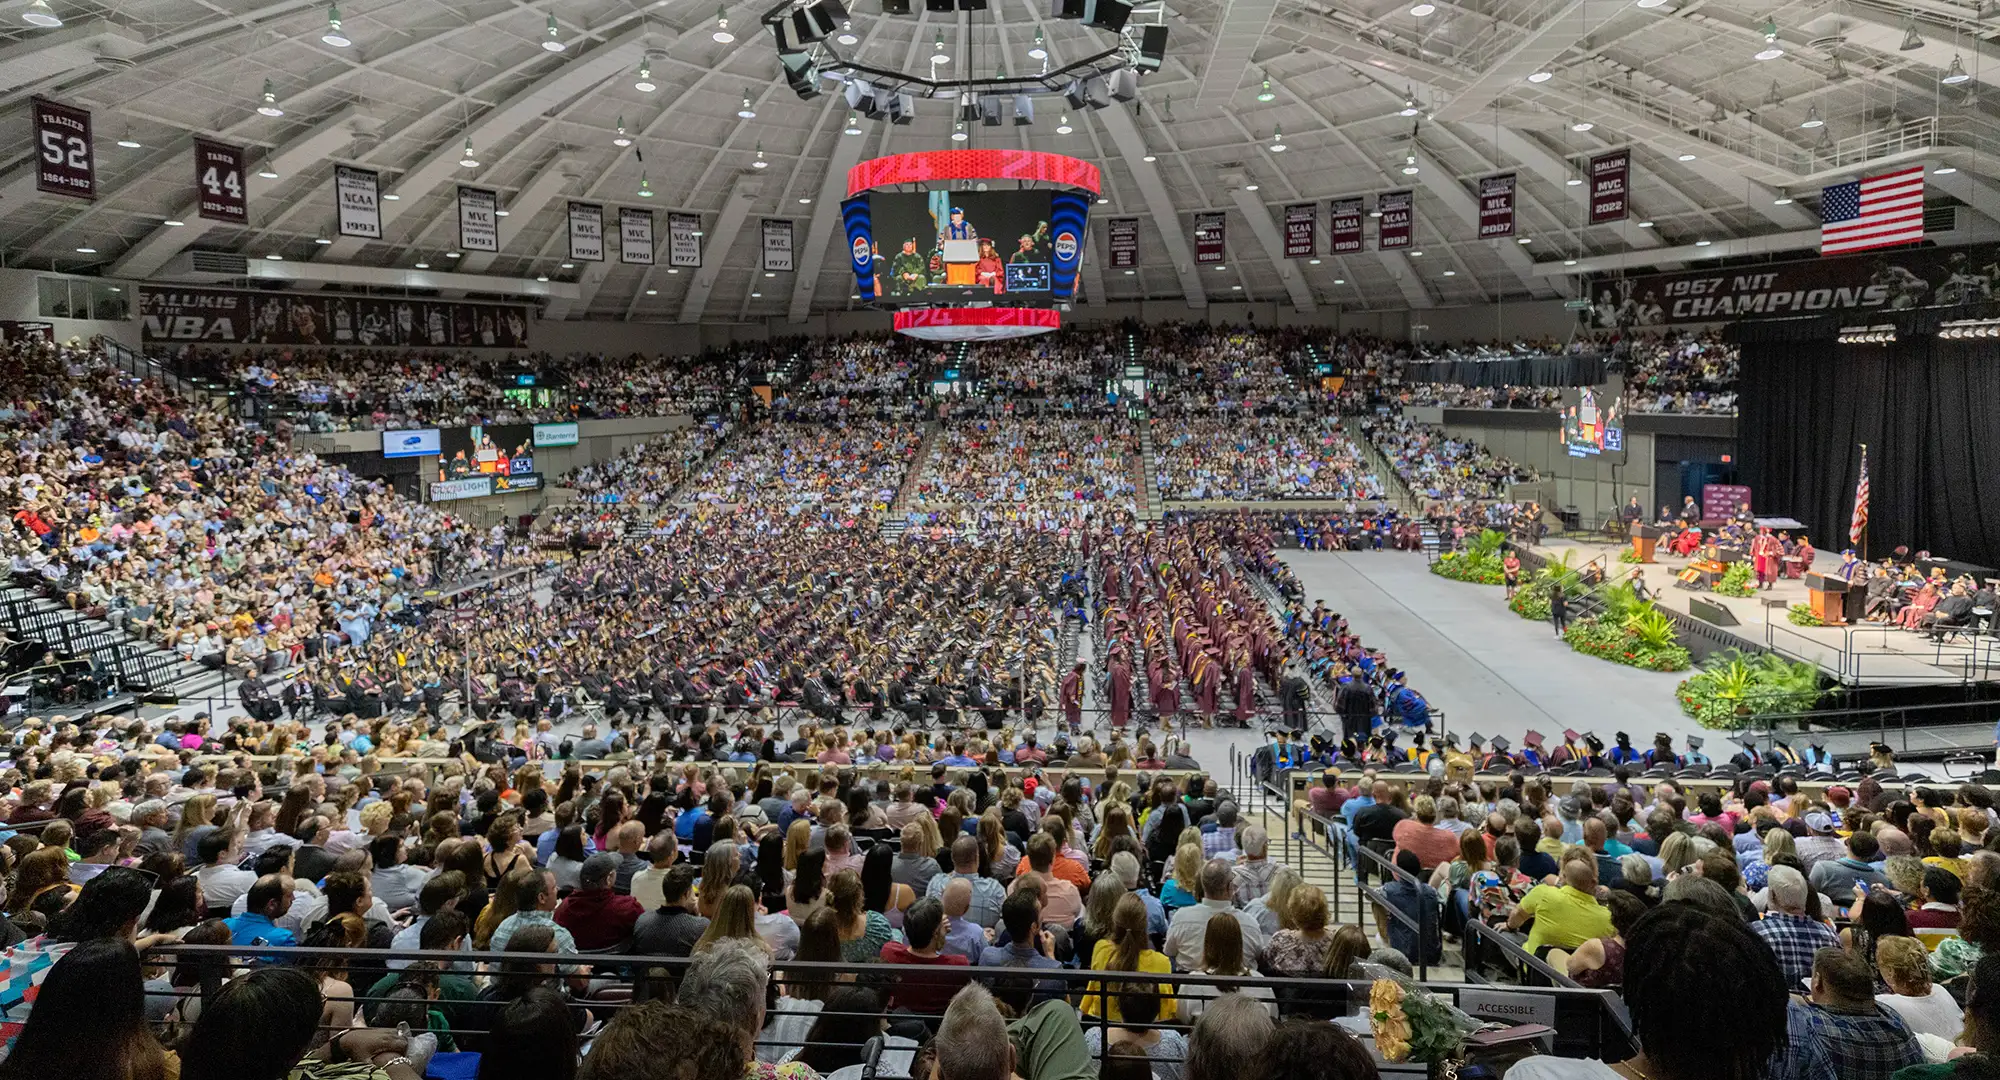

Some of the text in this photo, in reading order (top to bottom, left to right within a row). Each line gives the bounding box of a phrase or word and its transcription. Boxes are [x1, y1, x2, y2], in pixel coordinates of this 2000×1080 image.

[42, 114, 85, 132] FRAZIER
[41, 130, 88, 170] 52
[1595, 158, 1626, 172] SALUKI
[43, 172, 90, 188] 1964-1967
[202, 166, 242, 198] 44
[1598, 179, 1621, 191] MVC
[344, 192, 373, 206] NCAA
[1487, 198, 1507, 209] MVC
[1596, 201, 1622, 214] 2022
[468, 211, 488, 221] MVC
[1384, 212, 1408, 223] NCAA
[346, 222, 375, 232] 1993
[1289, 223, 1311, 233] NCAA
[1335, 218, 1359, 228] NCAA
[1482, 223, 1511, 234] 2007
[577, 224, 595, 234] MVC
[628, 229, 645, 238] MVC
[1056, 242, 1076, 251] PEPSI
[1664, 273, 1779, 297] 1967 NIT
[1671, 284, 1890, 318] CHAMPIONS
[156, 306, 182, 315] THE
[140, 315, 236, 340] NBA
[545, 432, 576, 441] Banterra
[463, 481, 488, 491] LIGHT
[1477, 1003, 1535, 1015] ACCESSIBLE
